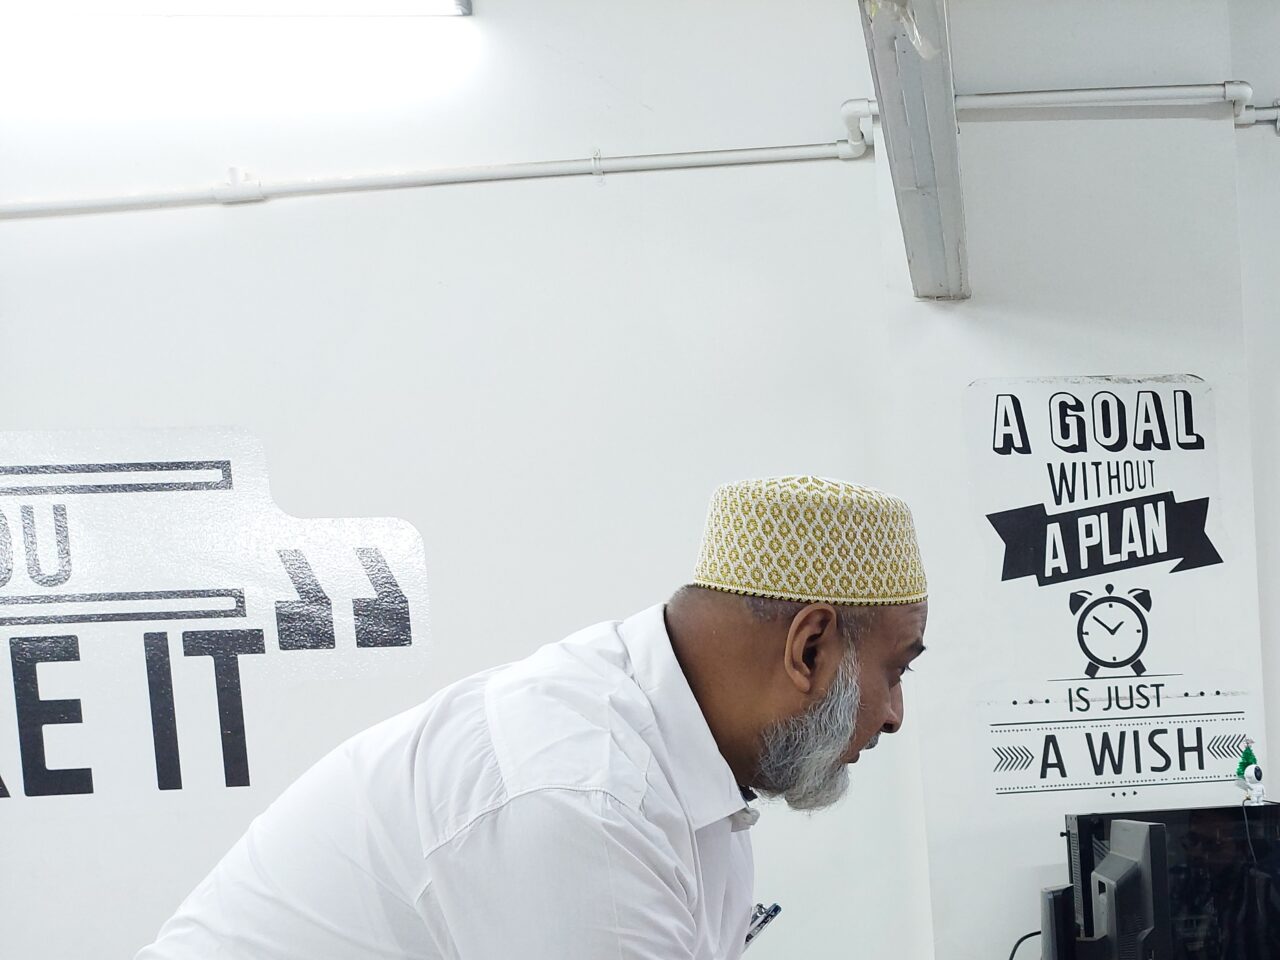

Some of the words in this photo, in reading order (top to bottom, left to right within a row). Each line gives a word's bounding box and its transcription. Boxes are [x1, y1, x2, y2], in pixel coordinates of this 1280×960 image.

[992, 393, 1032, 455] A
[1048, 389, 1205, 453] GOAL
[1046, 459, 1156, 506] WITHOUT
[1044, 522, 1069, 578] A
[1077, 500, 1169, 570] PLAN
[0, 635, 94, 798] E
[1067, 687, 1091, 713] IS
[1102, 683, 1165, 712] JUST
[1039, 734, 1068, 779] A
[1085, 726, 1206, 776] WISH
